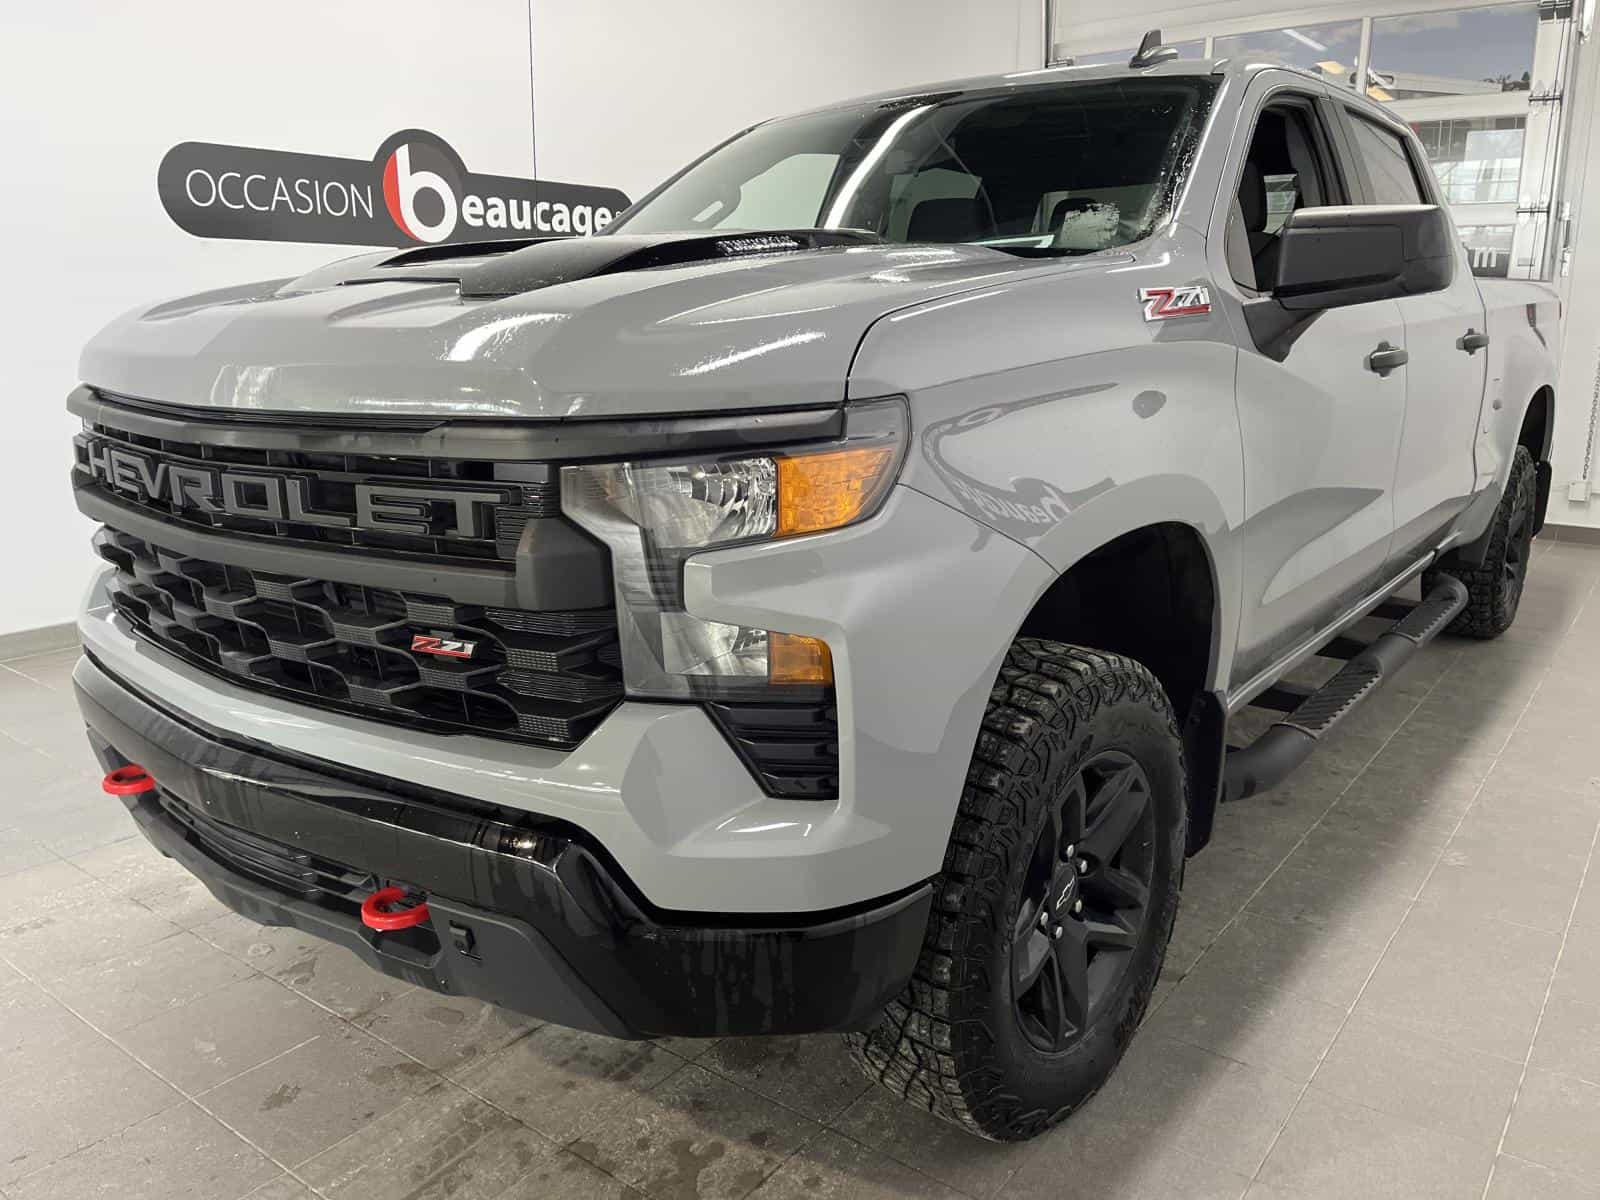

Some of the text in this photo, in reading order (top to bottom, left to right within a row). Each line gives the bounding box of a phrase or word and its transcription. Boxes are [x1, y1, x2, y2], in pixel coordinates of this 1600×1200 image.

[185, 168, 374, 219] OCCASION
[1138, 286, 1211, 321] Z71
[73, 436, 502, 539] CHEVROLET
[411, 634, 475, 658] Z71
